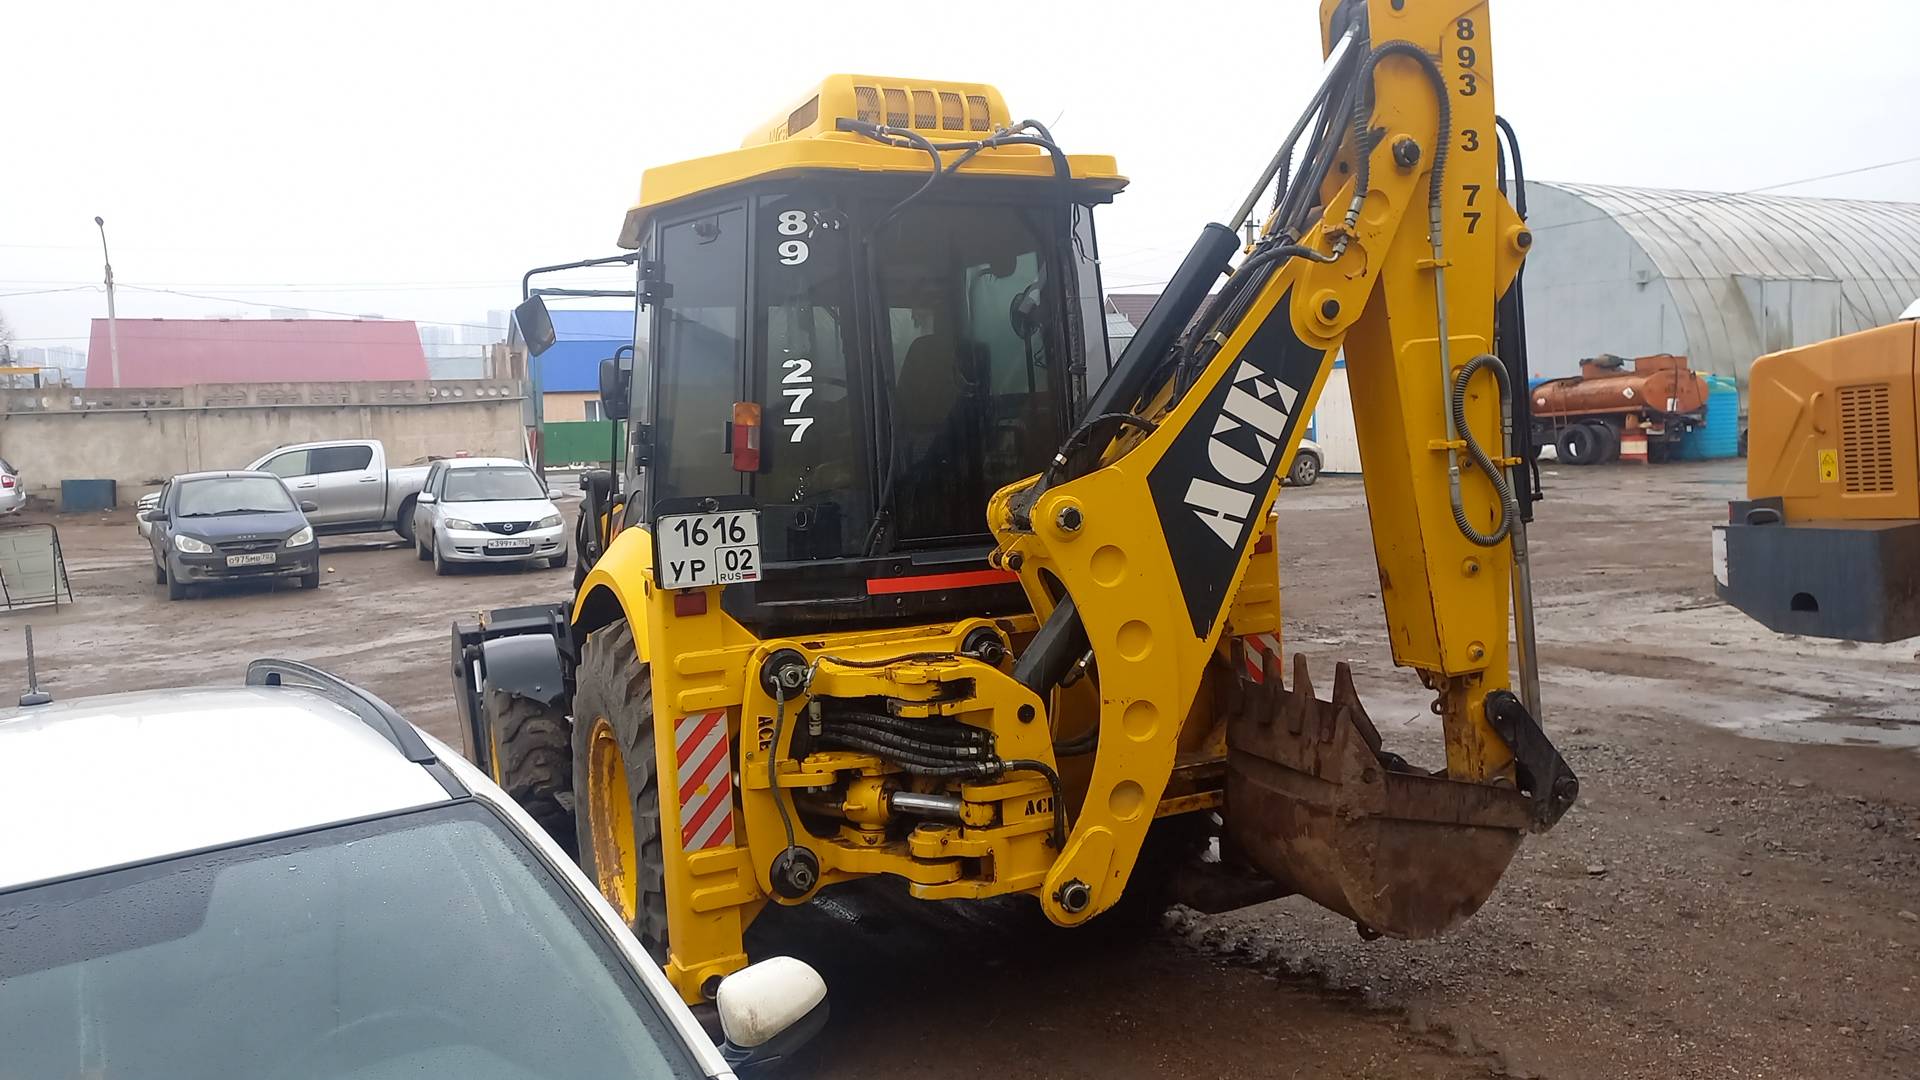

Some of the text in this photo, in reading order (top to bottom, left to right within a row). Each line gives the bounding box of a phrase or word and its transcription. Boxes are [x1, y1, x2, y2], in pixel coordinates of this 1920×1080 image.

[1184, 360, 1299, 550] ACE
[725, 549, 754, 571] 02
[720, 572, 742, 582] RUS
